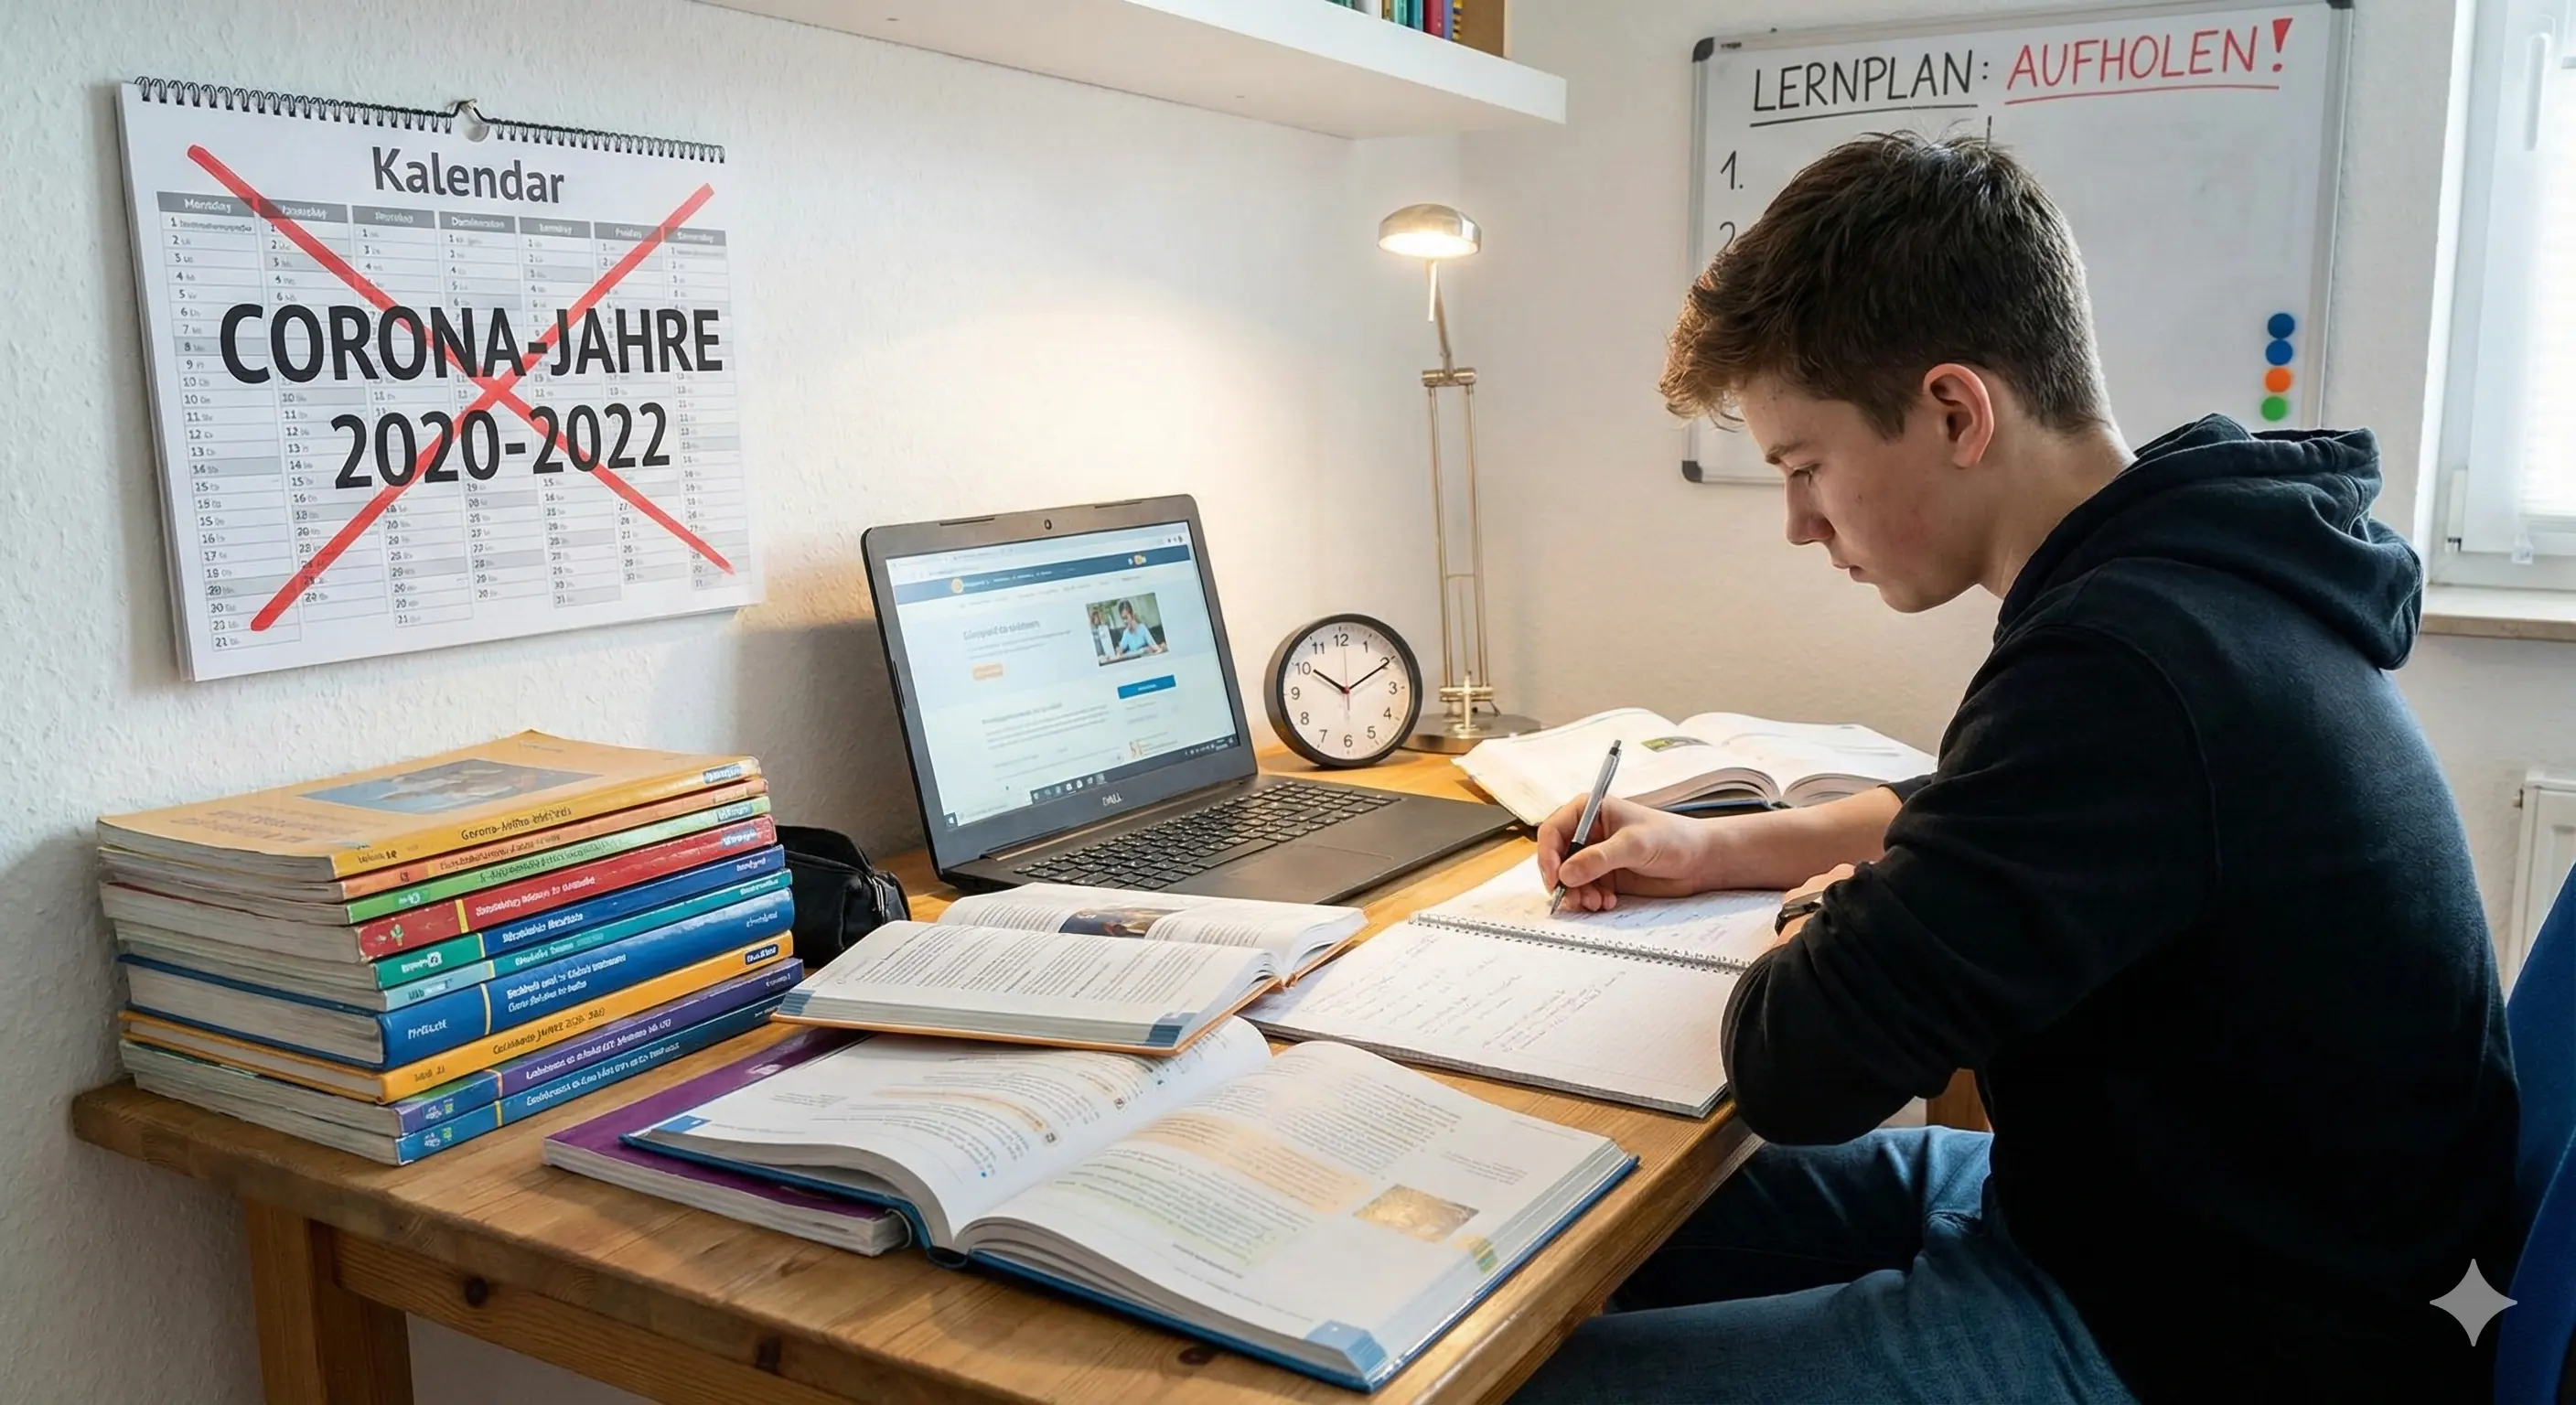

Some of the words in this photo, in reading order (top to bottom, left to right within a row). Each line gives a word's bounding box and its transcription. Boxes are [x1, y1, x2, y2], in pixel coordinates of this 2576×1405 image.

[1754, 49, 1989, 112] LERNPLAN:
[2006, 17, 2294, 91] AUFHOLEN!
[372, 146, 564, 203] Kalendar
[1720, 151, 1744, 190] 1.
[180, 307, 188, 317] 6
[182, 324, 188, 335] 7
[185, 342, 191, 352] 8
[219, 303, 724, 383] CORONA-JAHRE
[187, 359, 193, 370] 9
[330, 402, 671, 489] 2020-2022
[1333, 633, 1349, 647] 12
[1363, 640, 1368, 653] 1
[1312, 642, 1325, 655] 11
[1295, 661, 1311, 675] 10
[1291, 687, 1300, 700] 9
[1389, 681, 1397, 694] 3
[1300, 712, 1309, 725] 8
[1383, 707, 1392, 720] 4
[1319, 729, 1328, 743] 7
[1367, 725, 1376, 739] 5
[1344, 735, 1353, 747] 6
